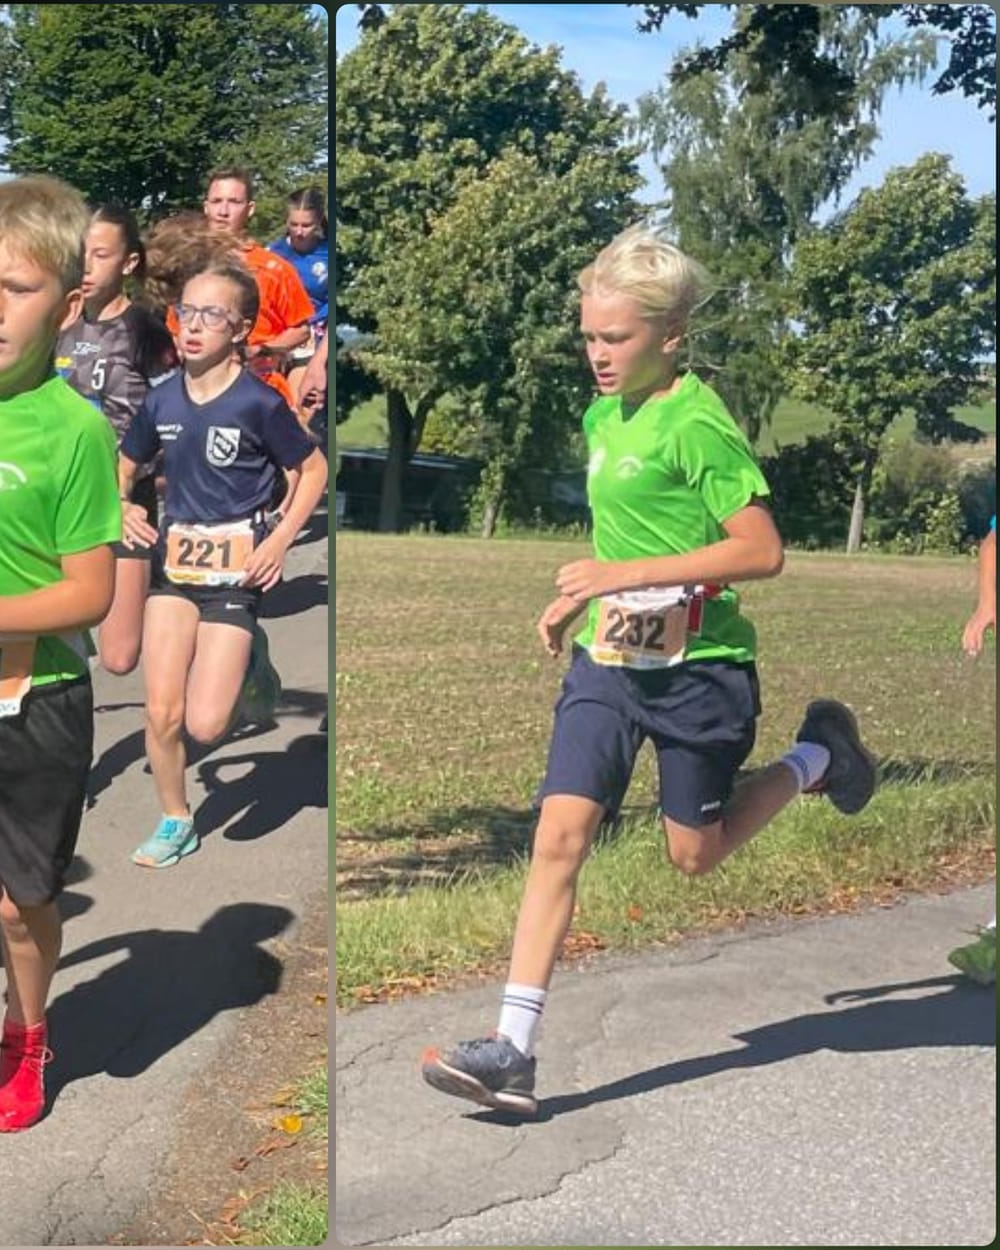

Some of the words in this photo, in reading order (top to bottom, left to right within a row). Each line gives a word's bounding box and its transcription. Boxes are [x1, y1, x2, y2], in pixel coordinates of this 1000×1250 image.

[91, 358, 107, 390] 5
[177, 538, 232, 569] 221
[604, 608, 665, 651] 232
